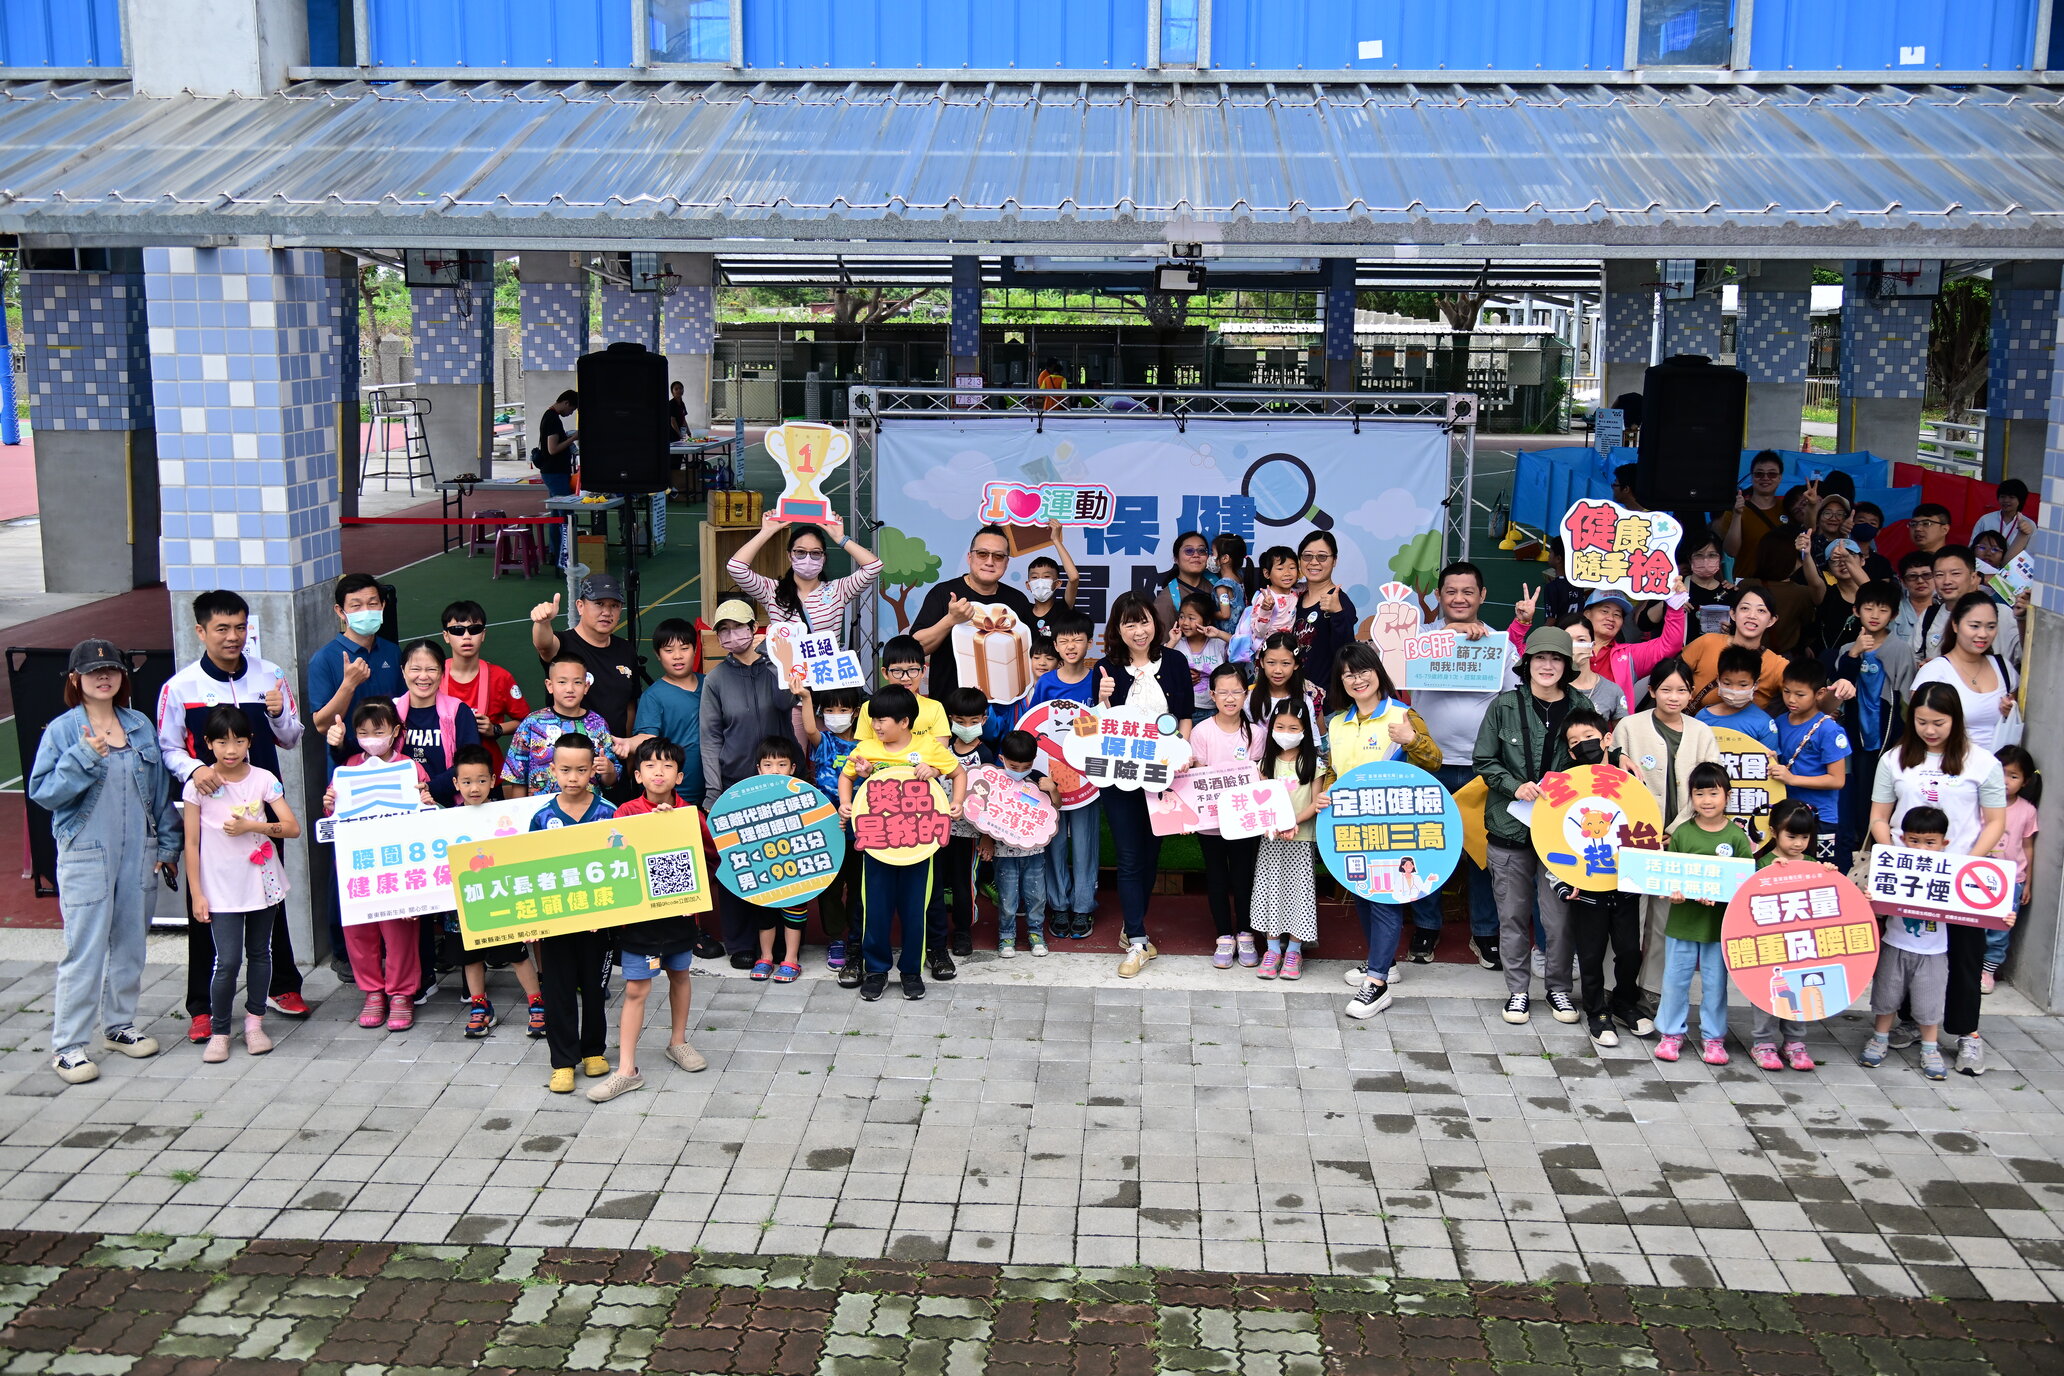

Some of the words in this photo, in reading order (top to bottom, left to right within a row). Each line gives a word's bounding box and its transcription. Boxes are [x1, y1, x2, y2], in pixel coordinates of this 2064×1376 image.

[797, 443, 816, 473] 1
[987, 488, 1007, 518] I
[1040, 489, 1108, 520] 運動
[1565, 501, 1652, 554] 健康
[1572, 548, 1673, 594] 隨手檢
[800, 638, 834, 659] 拒絕
[1404, 632, 1455, 660] BC肝
[1457, 645, 1503, 660] 篩了沒?
[811, 656, 858, 685] 菸品
[1429, 661, 1482, 672] 問我!問我!
[1101, 718, 1159, 740] 我就是
[1100, 736, 1157, 761] 保健
[983, 769, 1014, 791] 母嬰
[1084, 756, 1168, 784] 冒險王
[1193, 774, 1251, 792] 喝酒臉紅
[866, 779, 934, 814] 獎品
[1331, 785, 1445, 818] 定期健檢
[1539, 764, 1629, 808] 全家
[712, 791, 817, 833] 遠離代謝症候群
[990, 791, 1050, 827] 八大好禮
[1231, 793, 1249, 812] 我
[739, 815, 804, 844] 理想腰圍
[854, 812, 951, 850] 是我的
[987, 803, 1036, 837] 守護您
[1240, 809, 1277, 832] 運動
[1333, 821, 1446, 853] 監測三高
[1546, 844, 1618, 877] 一起
[1646, 858, 1721, 878] 活出健康
[1877, 851, 1952, 875] 全面禁止
[347, 864, 453, 899] 健康常保
[1646, 878, 1721, 896] 自信無限
[1874, 872, 1951, 903] 電子煙
[489, 887, 615, 920] 一起顧健康
[1749, 885, 1841, 926] 每天量
[1725, 921, 1877, 970] 體重及腰圍
